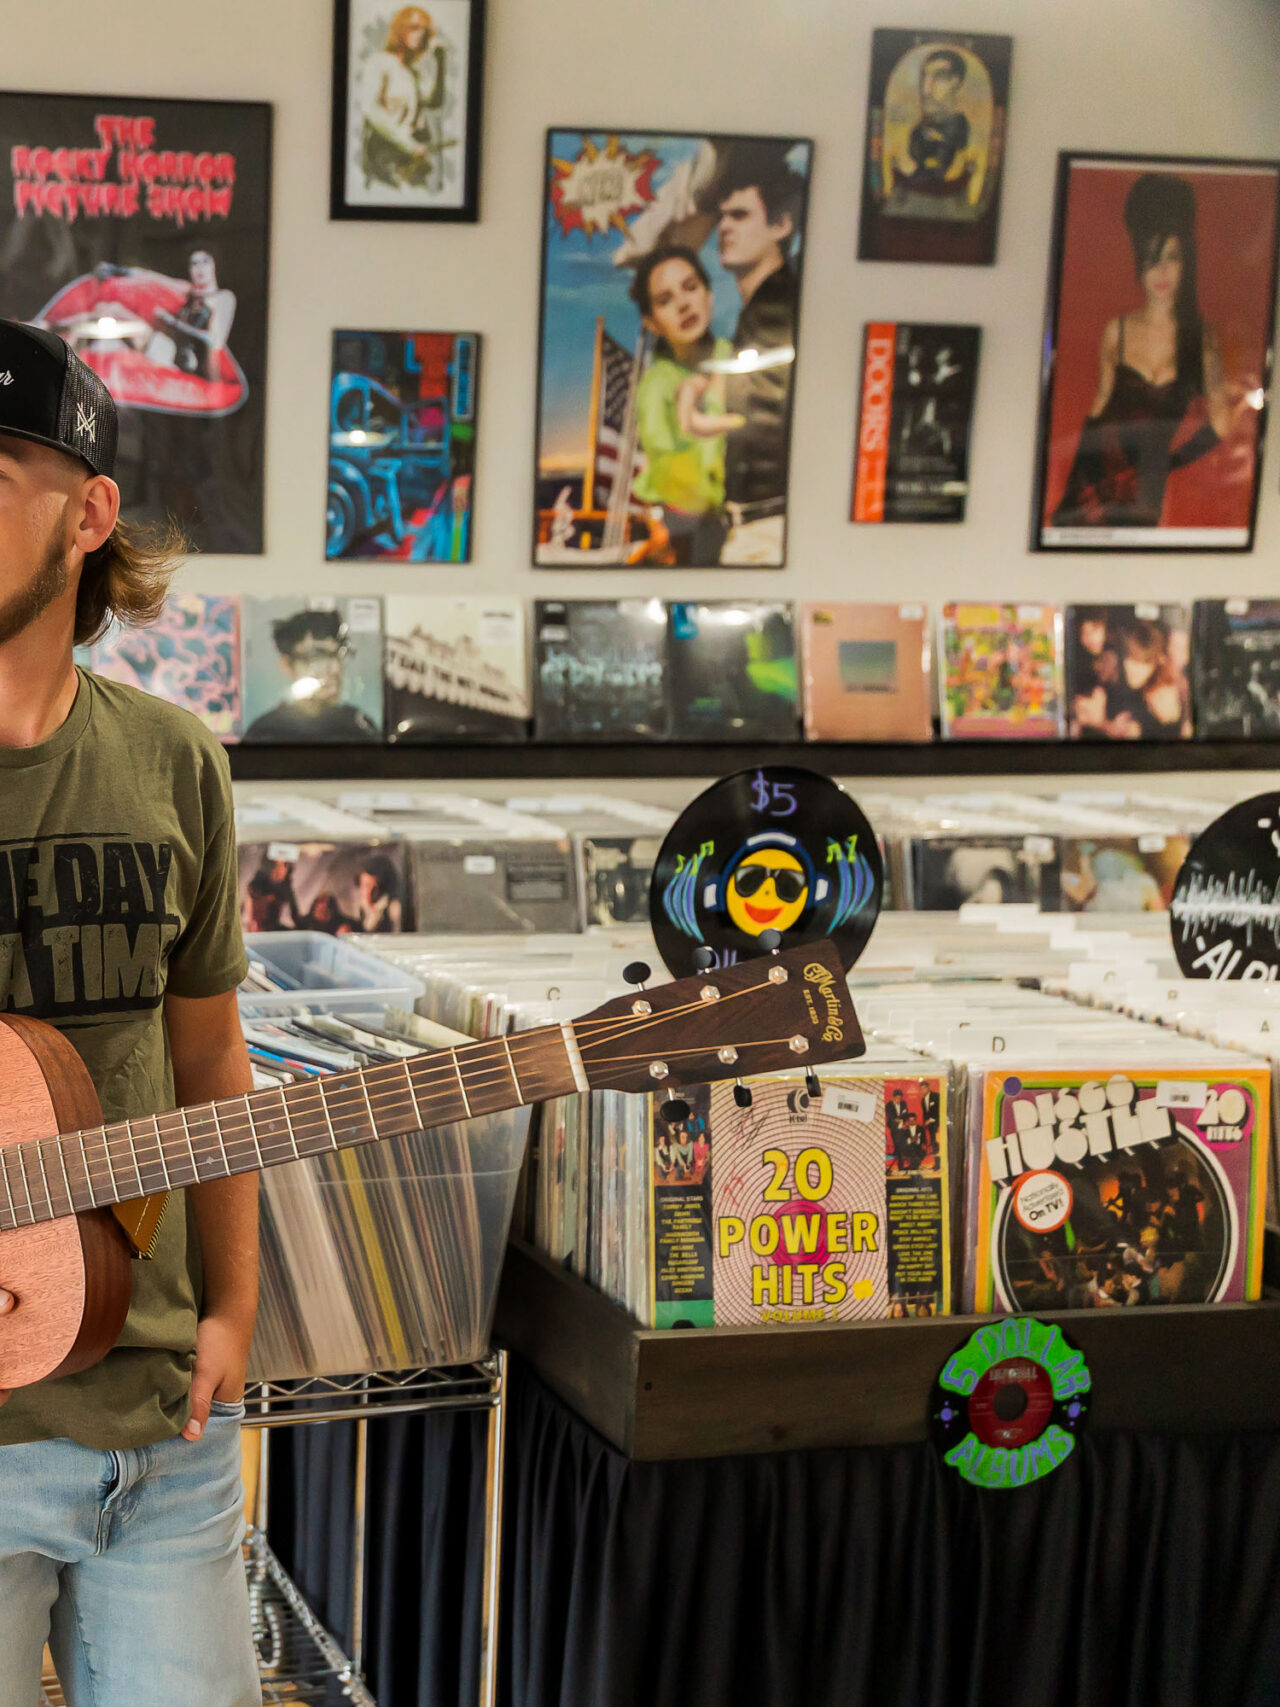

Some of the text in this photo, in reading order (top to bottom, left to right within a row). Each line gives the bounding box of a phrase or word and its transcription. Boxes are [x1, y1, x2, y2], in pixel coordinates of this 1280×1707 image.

[94, 114, 156, 150] THE
[11, 145, 236, 188] ROCKY HORROR
[14, 179, 233, 228] PICTURE SHOW
[861, 338, 893, 452] DOORS
[749, 769, 798, 817] $5
[53, 842, 172, 917] DAY
[992, 1036, 1005, 1053] D
[1012, 1073, 1135, 1132] DISCO
[1196, 1088, 1246, 1125] 20
[985, 1096, 1172, 1182] HUSTLE
[762, 1147, 834, 1202] 20
[719, 1211, 879, 1258] POWER
[1029, 1209, 1046, 1221] On
[751, 1262, 848, 1306] HITS
[762, 1308, 825, 1322] VOLUME
[943, 1319, 1092, 1396] 5 DOLLAR
[949, 1427, 1073, 1487] ALBUMS
